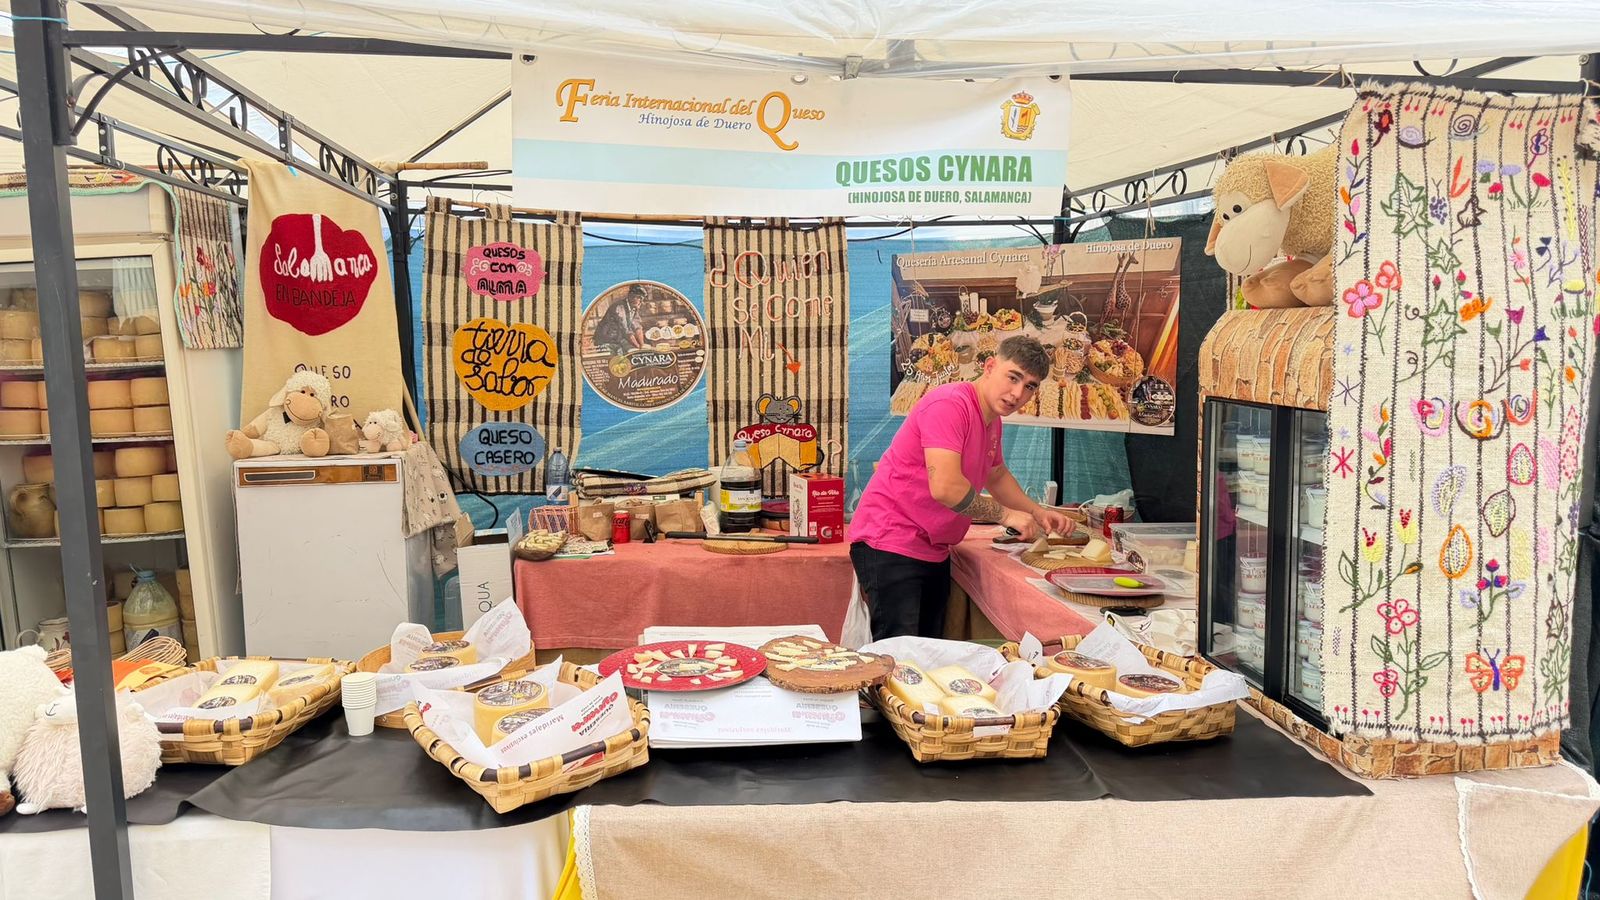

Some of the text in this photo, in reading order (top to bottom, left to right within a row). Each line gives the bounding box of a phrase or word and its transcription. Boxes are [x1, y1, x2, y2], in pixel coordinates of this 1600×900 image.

[555, 78, 826, 151] Feria Internacional del Queso
[638, 112, 752, 130] Hinojosa de Duero
[835, 154, 1033, 186] QUESOS CYNARA
[848, 189, 1032, 205] (HINOJOSA DE DUERO, SALAMANCA)
[1086, 240, 1173, 255] Hinojosa de Duero
[940, 251, 988, 267] Artesanal
[989, 251, 1030, 267] Cynara
[276, 284, 357, 307] EN BANDEJA
[738, 325, 775, 361] Mi
[461, 347, 492, 367] de
[631, 354, 673, 366] CYNARA
[901, 358, 916, 375] 25
[617, 373, 679, 390] Madurado
[478, 429, 533, 446] QUESO
[736, 424, 814, 444] Queso Cynara
[474, 449, 536, 466] CASERO
